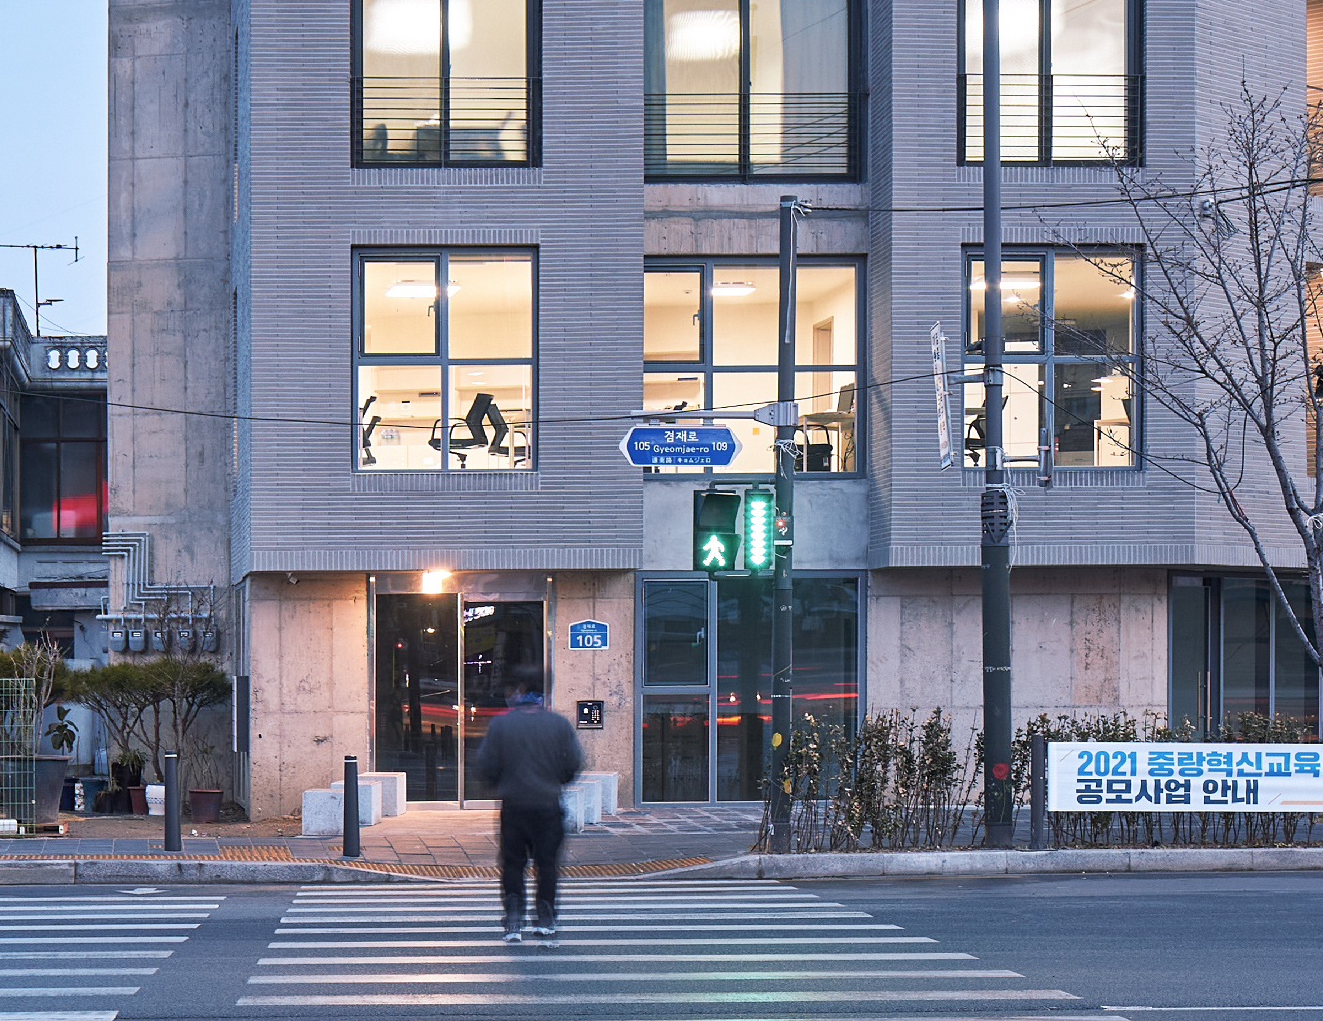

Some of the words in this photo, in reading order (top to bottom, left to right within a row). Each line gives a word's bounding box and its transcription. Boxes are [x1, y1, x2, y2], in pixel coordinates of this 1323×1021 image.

[664, 430, 699, 443] 겸재로
[633, 441, 651, 451] 105
[653, 444, 710, 455] Gyeomjae-ro
[711, 441, 728, 451] 109
[576, 635, 602, 647] 105
[1076, 750, 1138, 778] 2021
[1075, 779, 1192, 806] 공모사업
[1202, 779, 1259, 806] 안내
